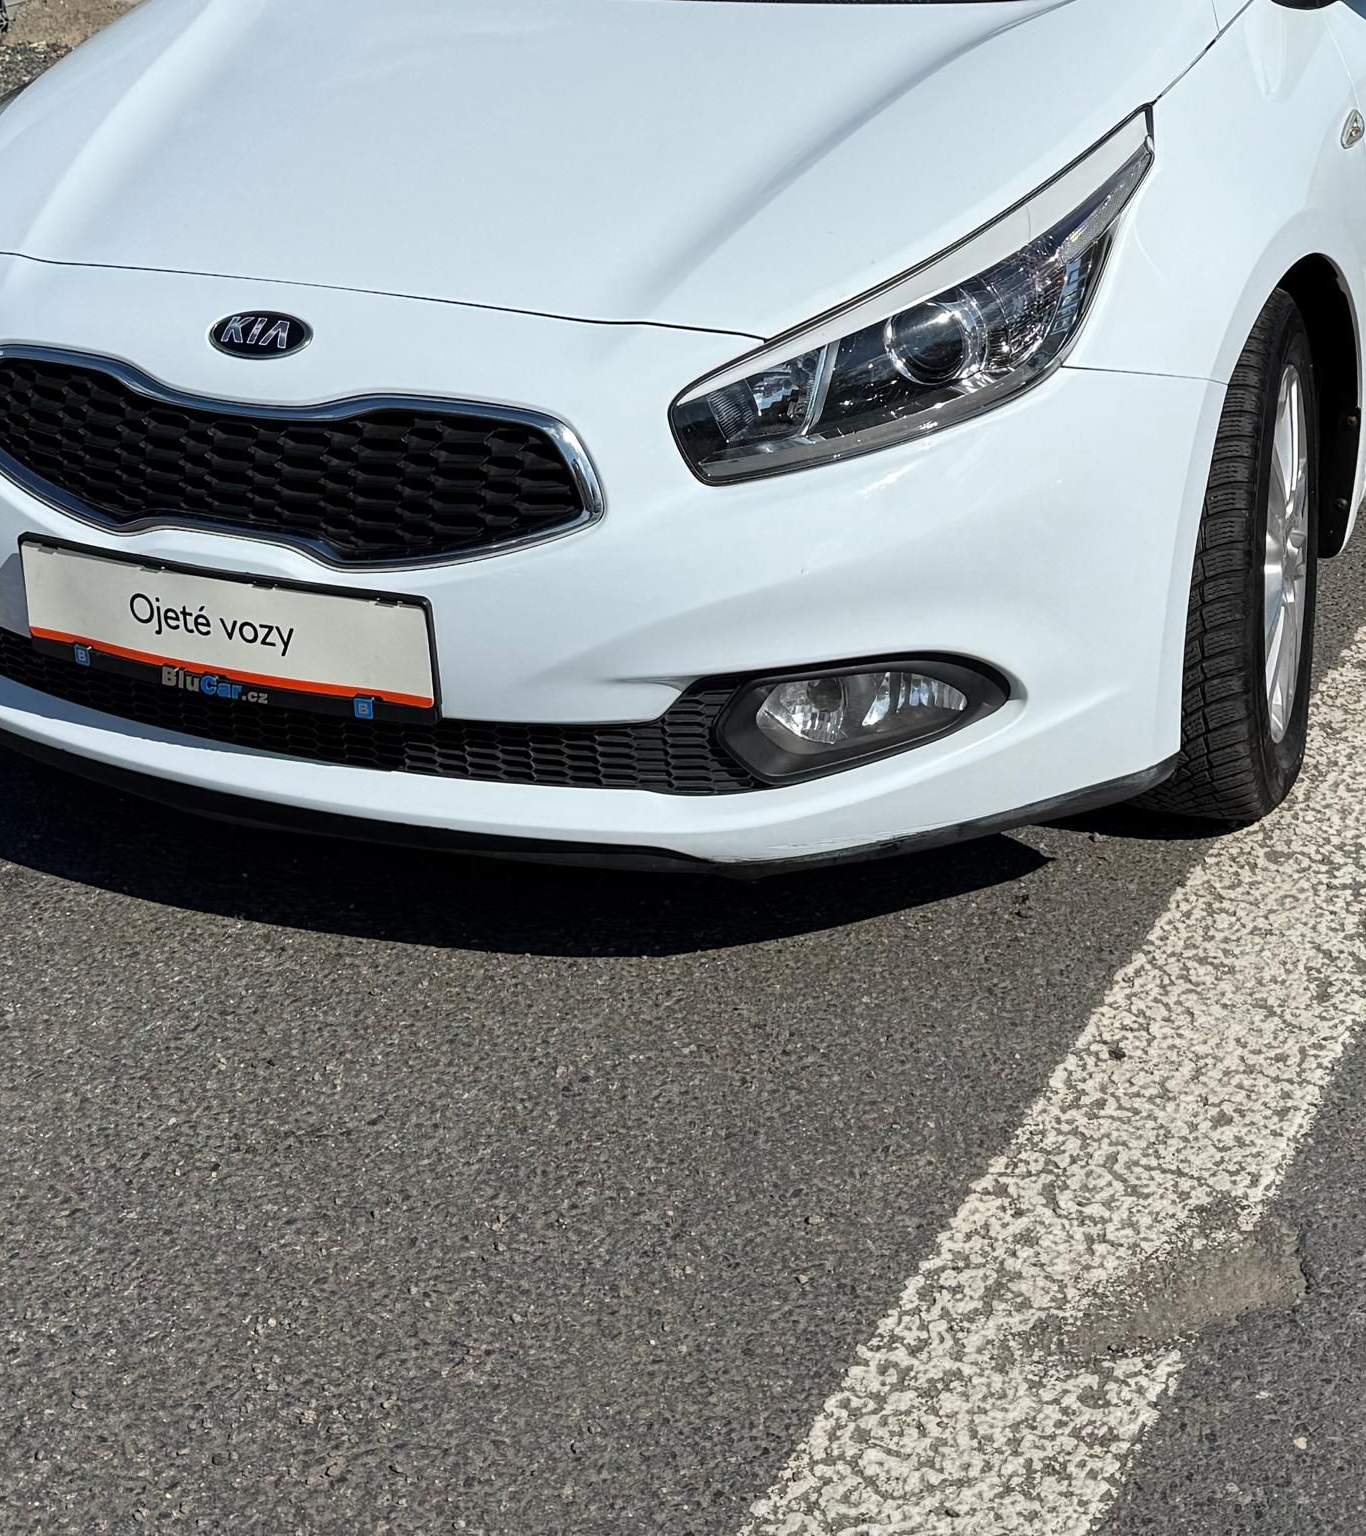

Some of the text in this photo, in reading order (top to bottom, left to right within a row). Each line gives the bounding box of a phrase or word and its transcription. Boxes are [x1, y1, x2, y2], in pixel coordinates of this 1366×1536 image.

[220, 316, 290, 349] KIA
[129, 592, 295, 657] Ojeté vozy
[161, 666, 268, 705] BluCar.cz
